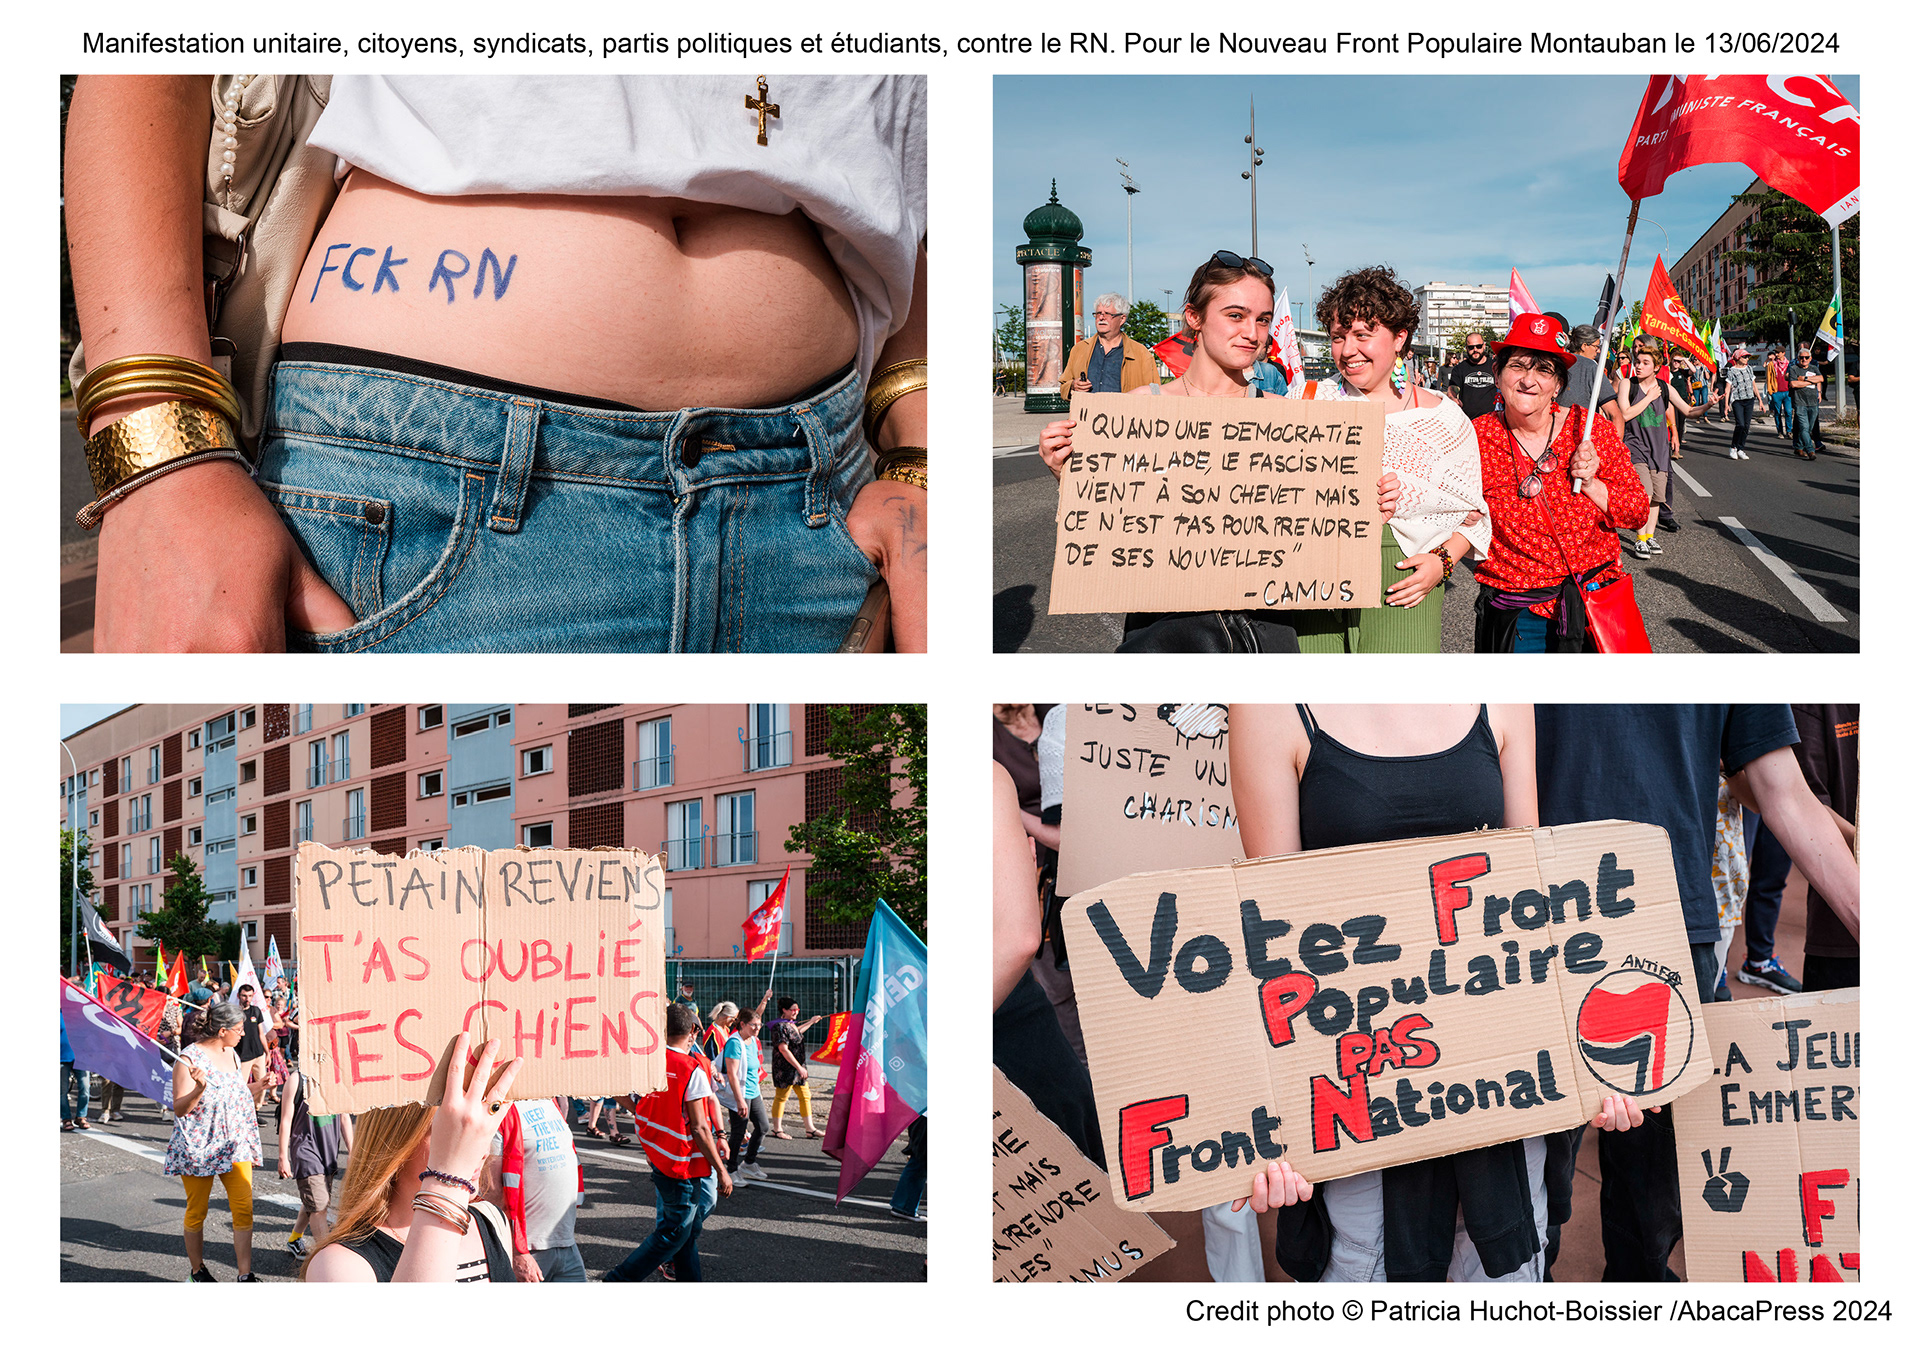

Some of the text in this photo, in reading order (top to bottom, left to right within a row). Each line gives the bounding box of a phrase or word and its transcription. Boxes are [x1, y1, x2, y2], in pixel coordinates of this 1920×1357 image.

[1636, 131, 1668, 148] PARTI
[1737, 99, 1852, 157] FRANÇAIS
[310, 243, 518, 305] FCK RN
[1645, 313, 1713, 365] Tarn-et-Garonne
[1175, 421, 1212, 440] UNE
[1069, 451, 1116, 473] EST
[1222, 452, 1238, 471] LE
[1156, 477, 1170, 503] À
[1181, 484, 1220, 504] SON
[1229, 484, 1305, 505] CHEVET
[1064, 507, 1370, 539] CE N'EST PAS POUR PRENDRE
[1065, 542, 1098, 567] DE
[1112, 547, 1154, 568] SES
[1080, 741, 1171, 778] JUSTE
[1086, 852, 1636, 999] Votez Front
[302, 930, 431, 984] T'AS
[307, 1008, 436, 1086] TES
[1336, 1013, 1441, 1078] PAS
[1714, 1042, 1752, 1077] A
[1119, 1049, 1567, 1201] Front National
[1001, 1179, 1100, 1248] PRENDRE
